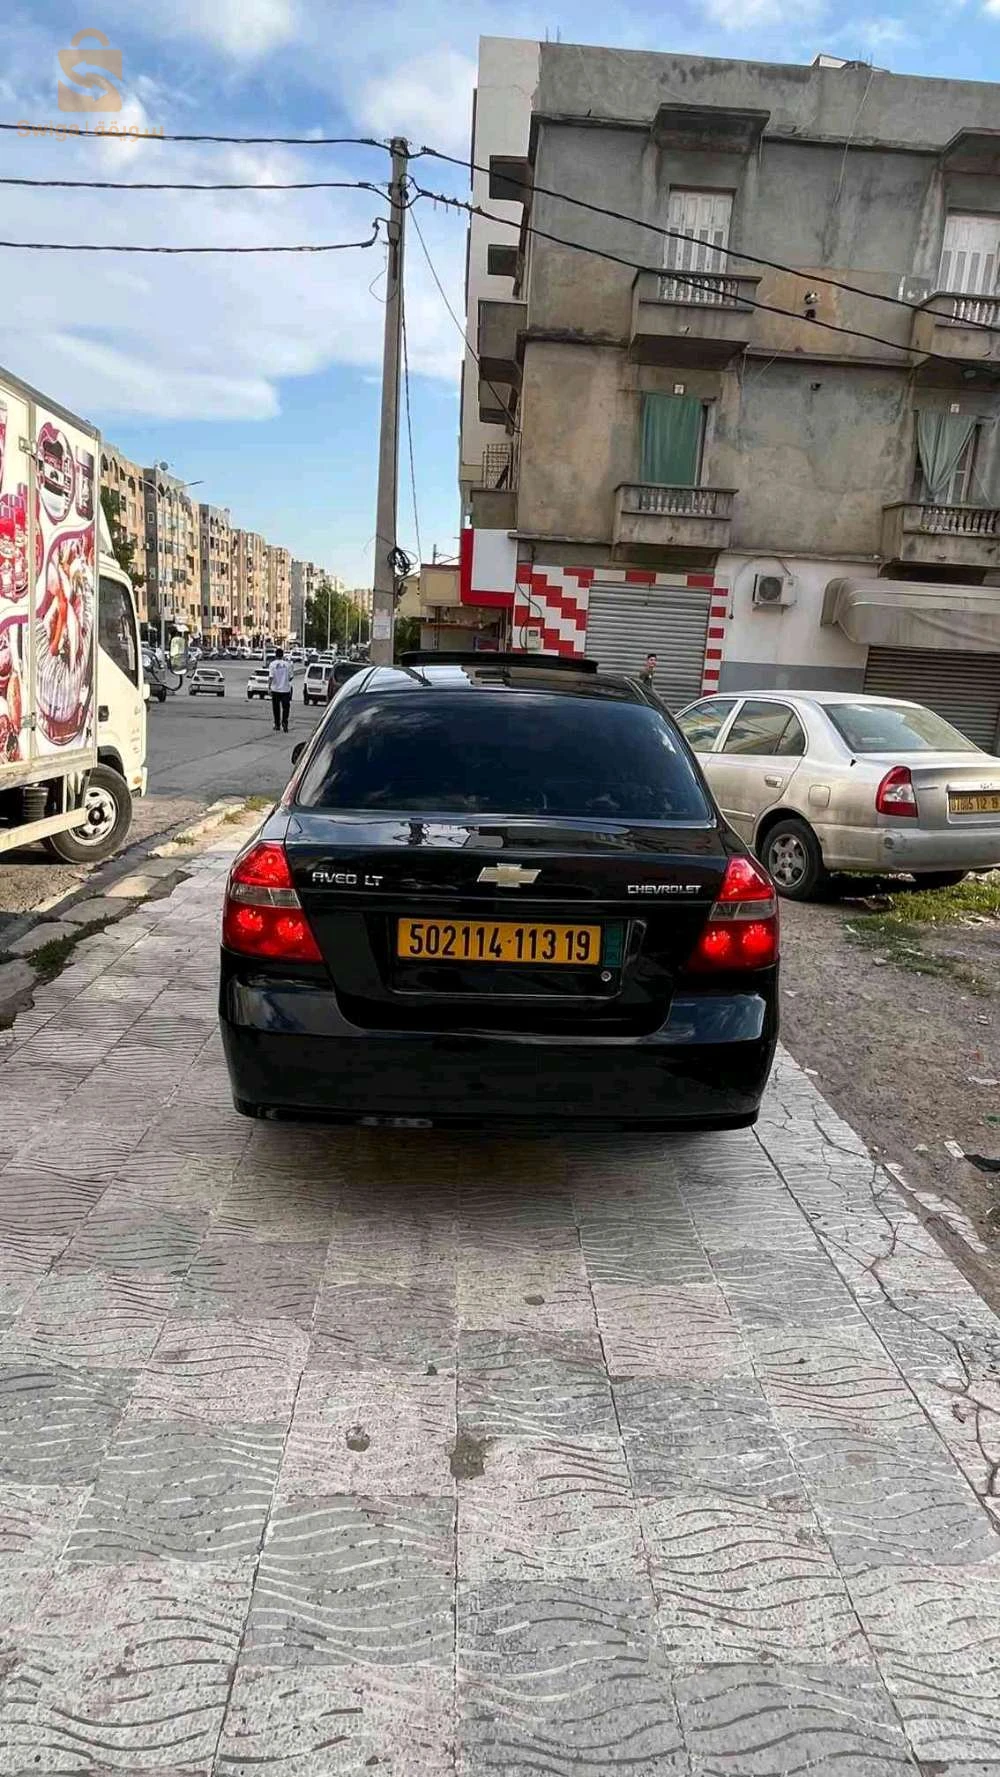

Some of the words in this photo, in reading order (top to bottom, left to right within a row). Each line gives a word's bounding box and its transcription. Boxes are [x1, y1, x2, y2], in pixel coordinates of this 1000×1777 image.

[312, 871, 357, 884] AVEO
[364, 875, 384, 886] LT
[627, 884, 703, 895] CHEVROLET
[565, 929, 591, 961] 19
